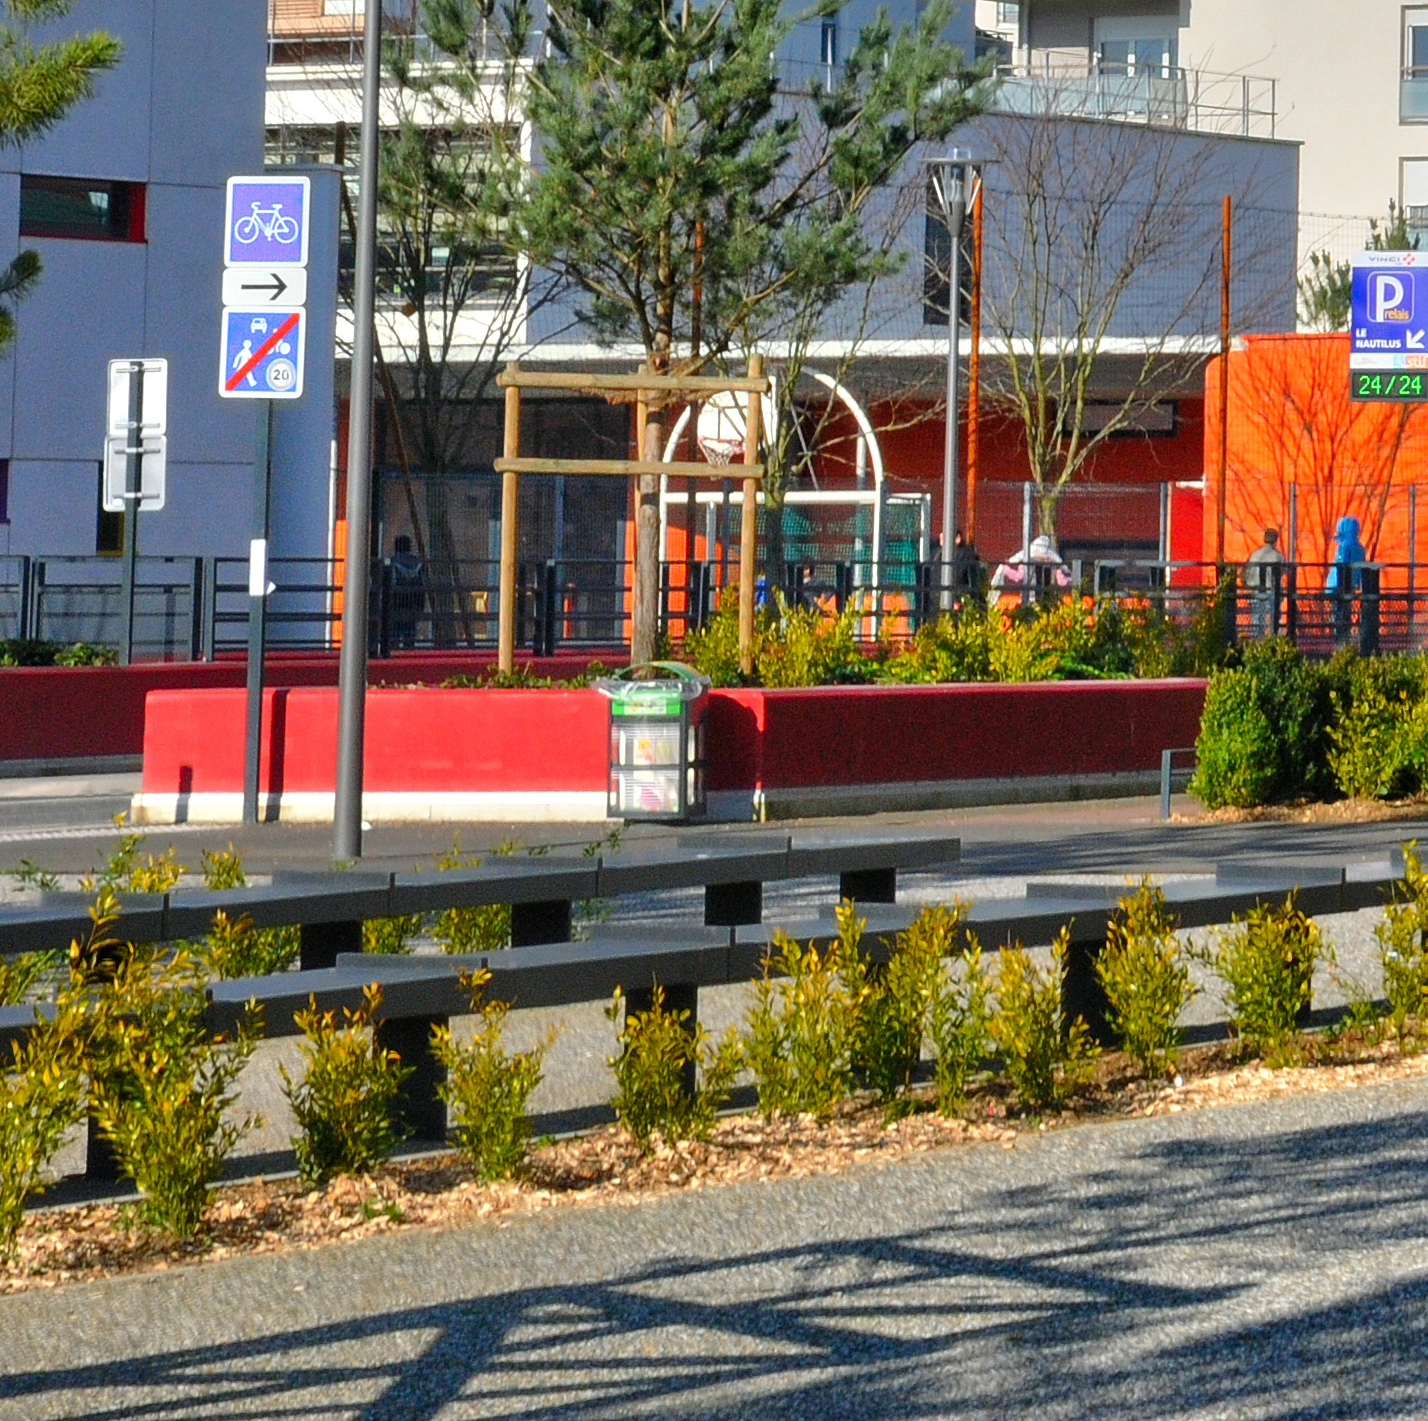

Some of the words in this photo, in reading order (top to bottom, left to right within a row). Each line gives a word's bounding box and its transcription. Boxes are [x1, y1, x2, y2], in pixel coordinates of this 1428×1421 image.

[1376, 275, 1404, 322] P
[1355, 328, 1367, 338] LE
[1355, 339, 1401, 348] NAUTILUS
[273, 369, 290, 381] 20
